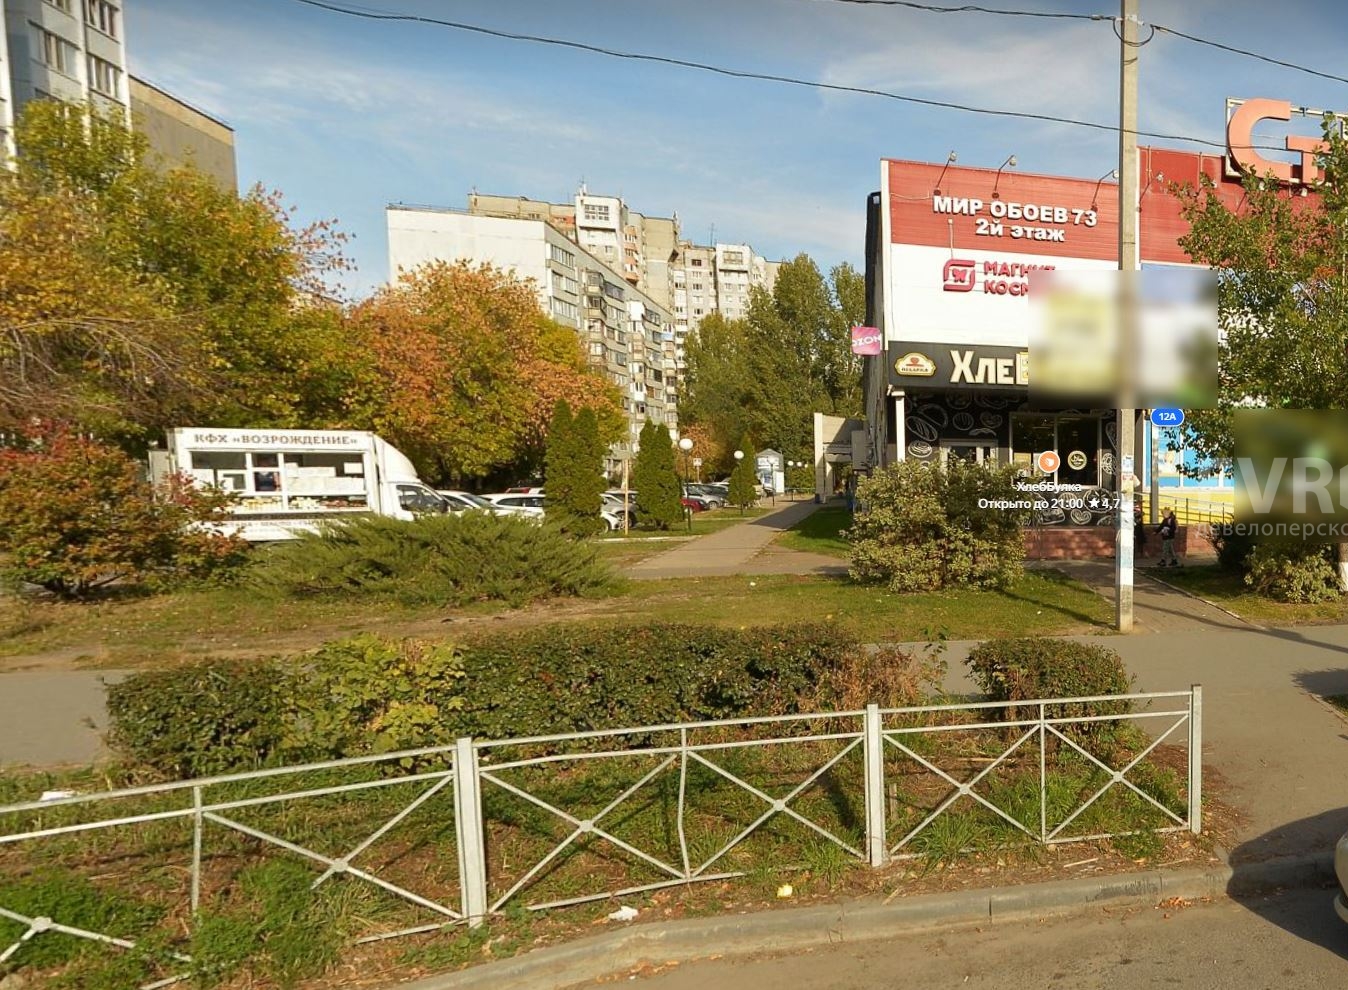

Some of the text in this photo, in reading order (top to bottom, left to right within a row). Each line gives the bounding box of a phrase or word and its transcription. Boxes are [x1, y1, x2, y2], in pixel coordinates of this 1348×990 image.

[933, 195, 1098, 227] МИР ОБОЕВ 73
[975, 218, 1066, 242] 2й этаж
[194, 434, 228, 443] КФХ
